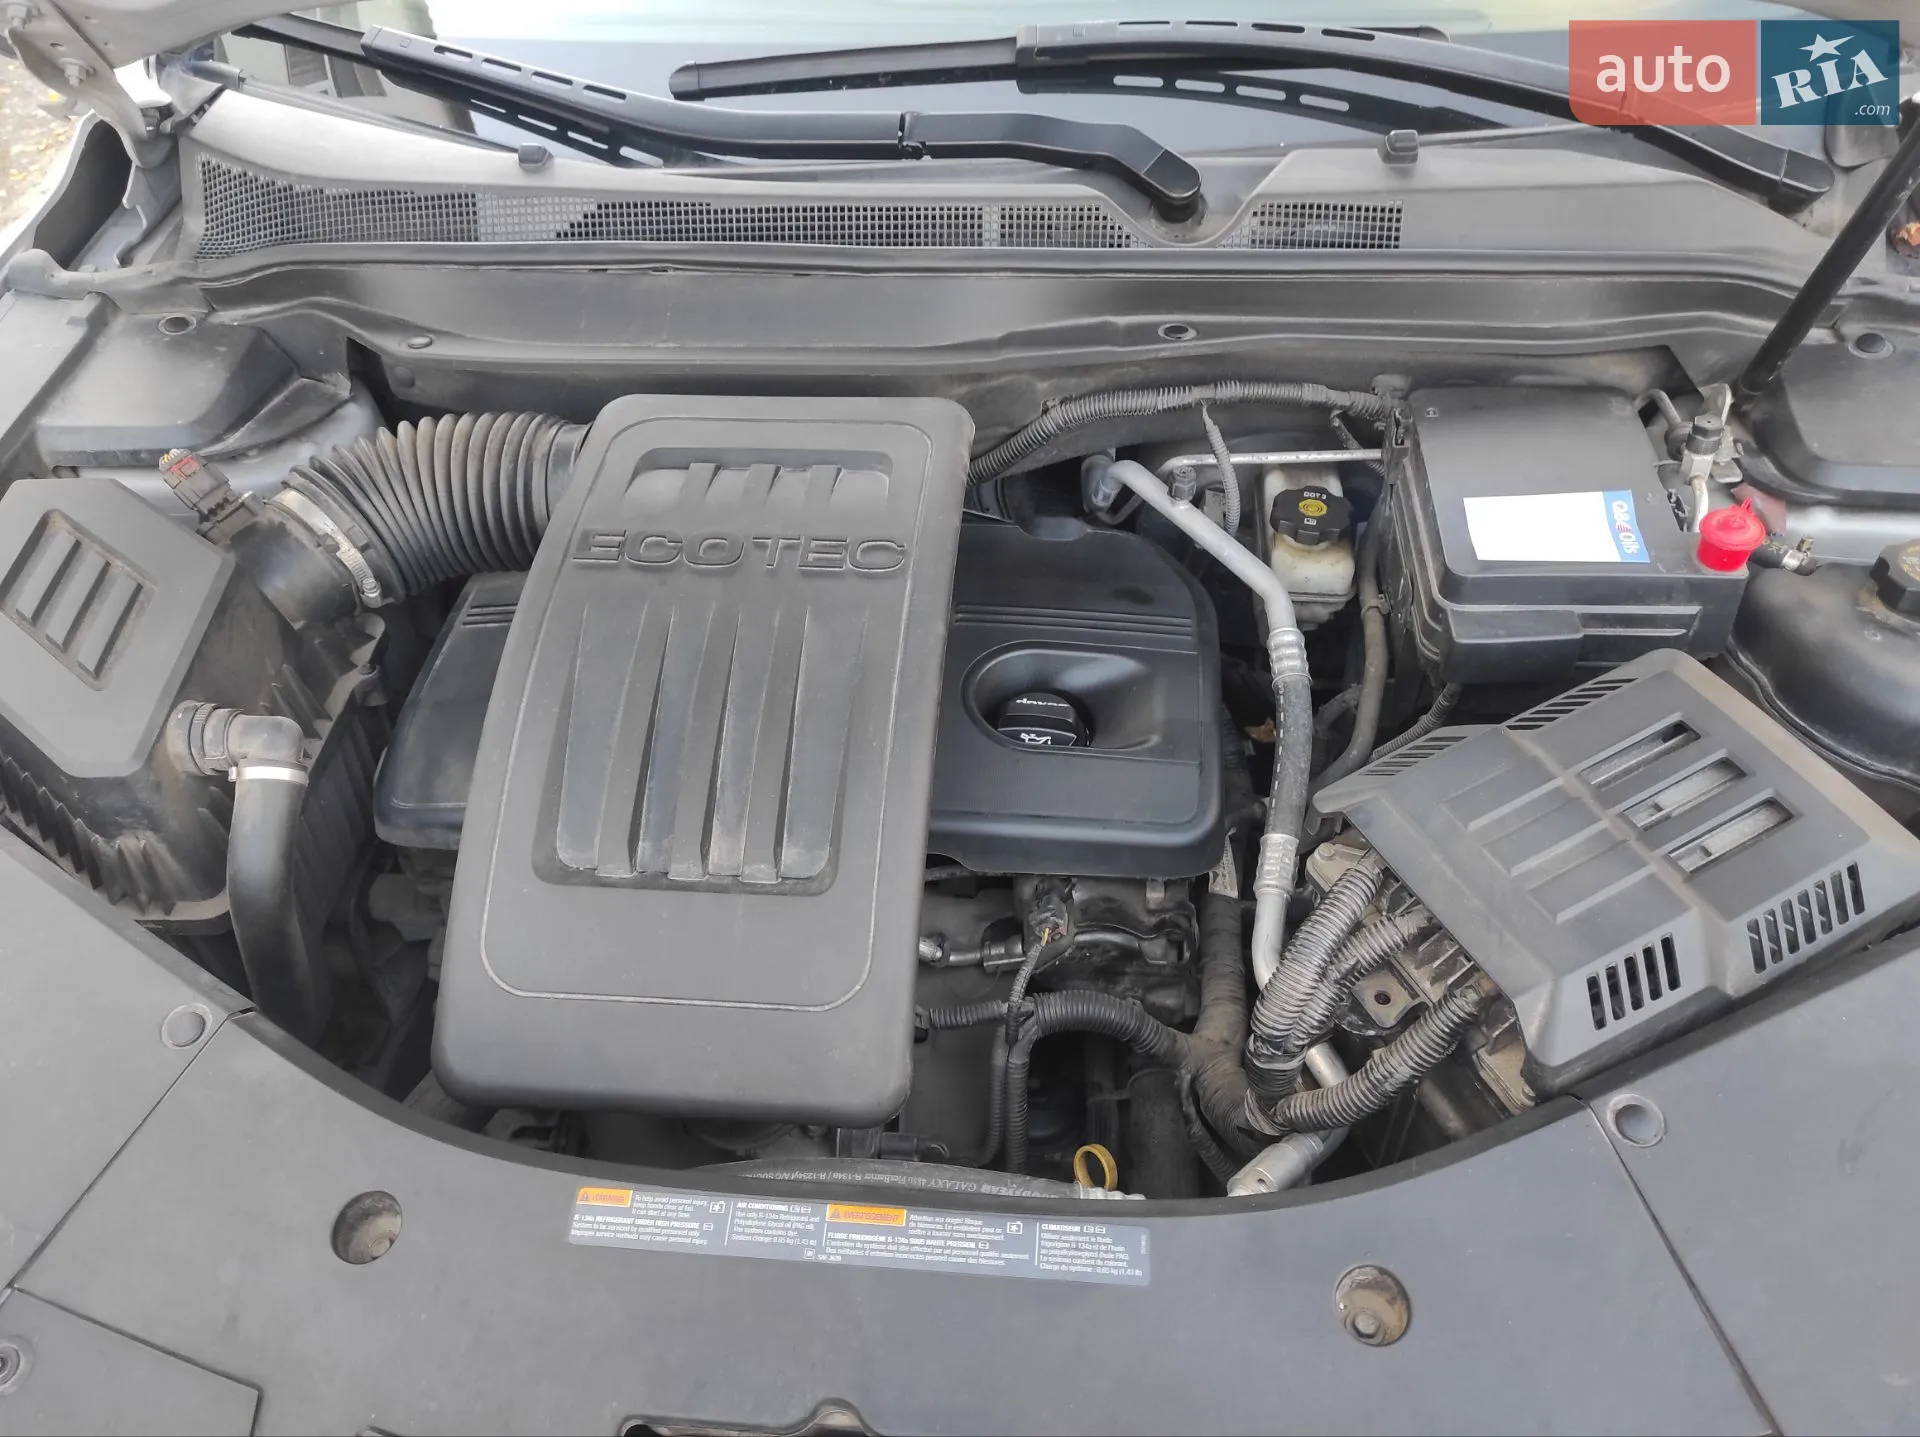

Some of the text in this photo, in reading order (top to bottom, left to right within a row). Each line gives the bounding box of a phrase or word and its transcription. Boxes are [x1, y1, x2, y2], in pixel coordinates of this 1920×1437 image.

[572, 529, 907, 571] ECOTEC
[832, 1172, 861, 1181] R-134a
[928, 1178, 977, 1192] GALAXY
